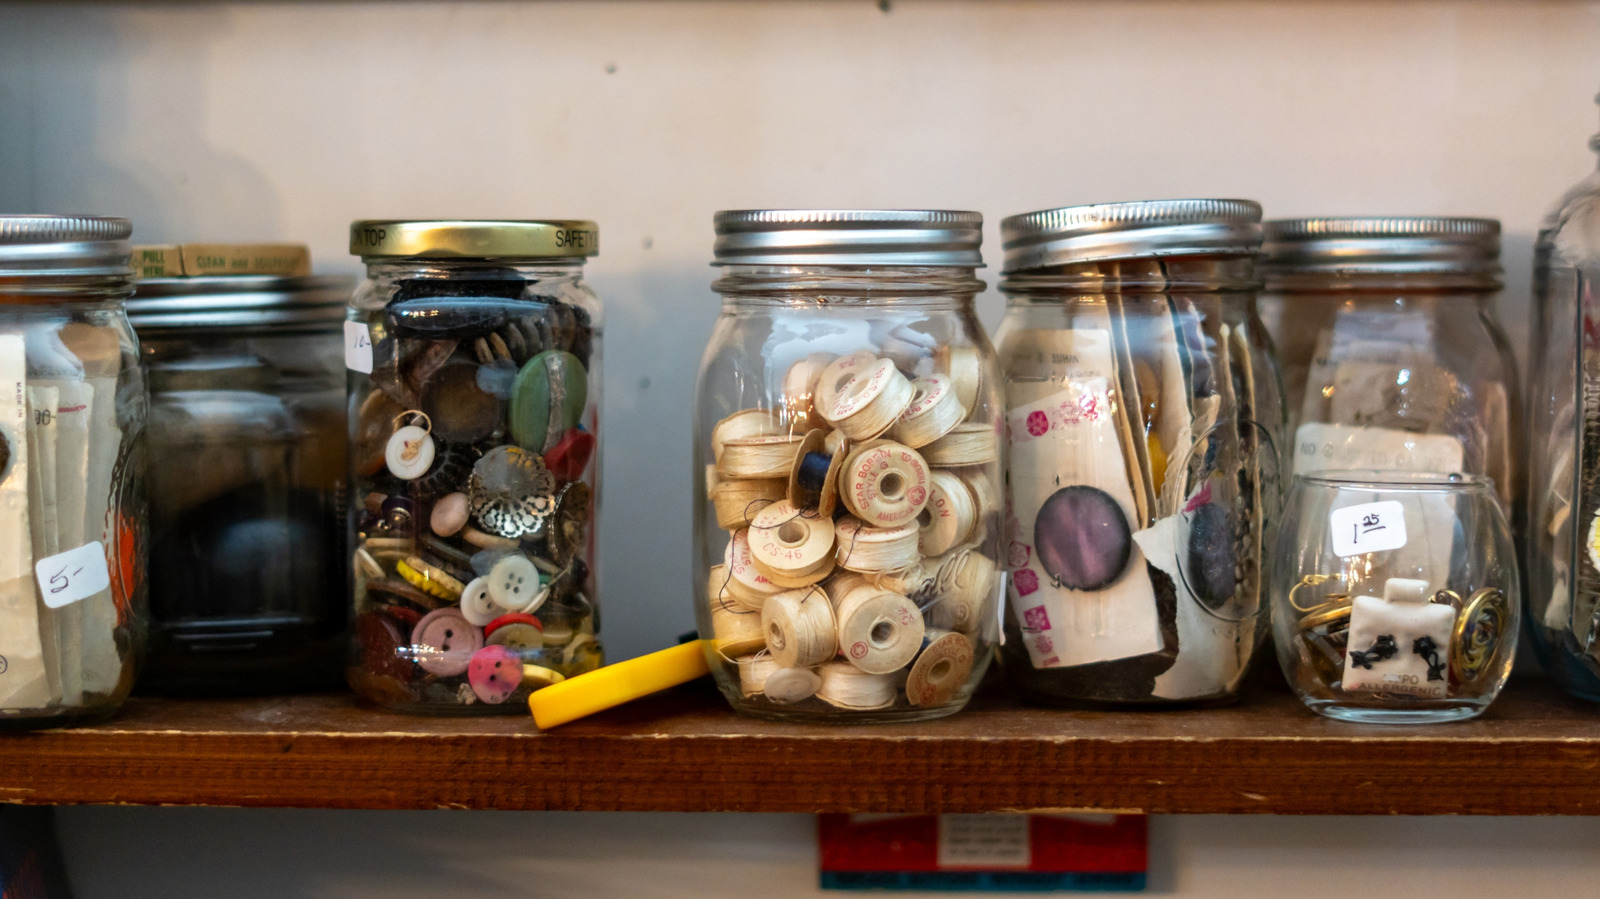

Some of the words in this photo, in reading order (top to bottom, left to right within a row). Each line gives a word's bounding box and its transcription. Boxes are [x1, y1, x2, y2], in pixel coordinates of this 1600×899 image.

[364, 228, 387, 247] TOP
[142, 249, 164, 264] PULL
[866, 471, 879, 500] STYLE
[855, 482, 871, 510] STAR
[876, 505, 915, 522] AMERICAN
[762, 541, 803, 561] CS-46
[1358, 682, 1442, 696] ALLERGENIC
